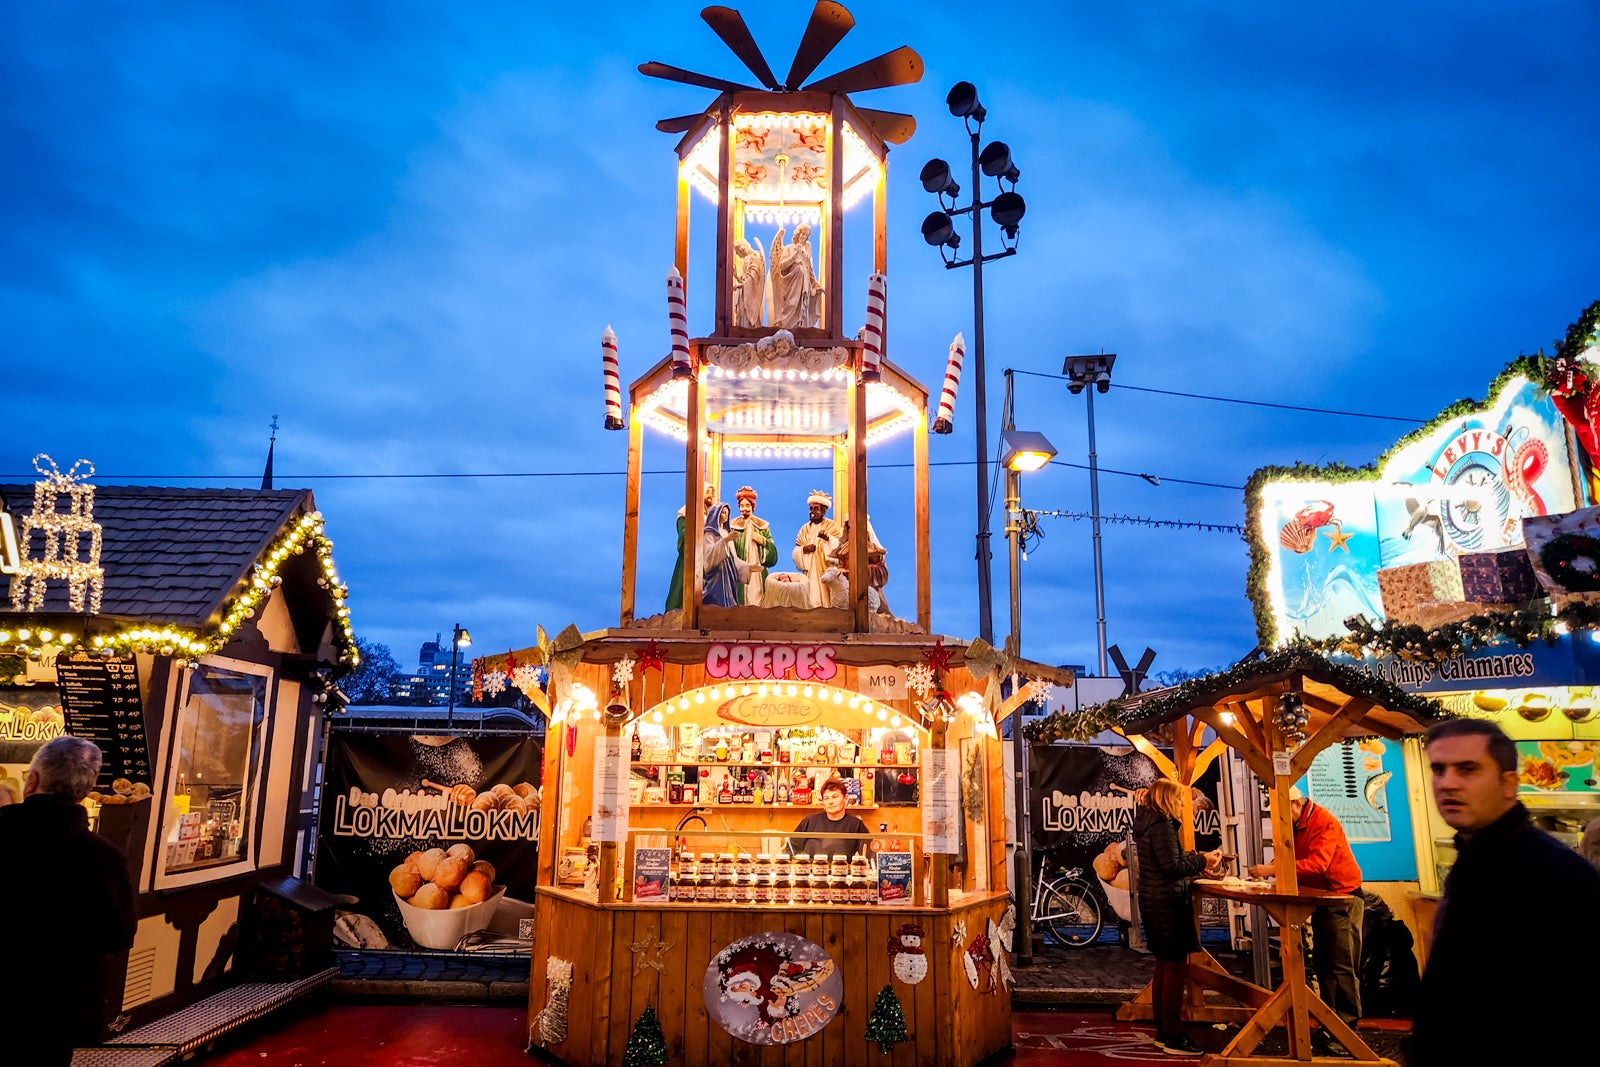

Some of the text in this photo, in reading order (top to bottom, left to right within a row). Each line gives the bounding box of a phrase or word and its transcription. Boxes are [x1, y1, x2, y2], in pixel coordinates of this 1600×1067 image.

[1433, 431, 1505, 480] LEVY'S
[706, 644, 838, 681] CREPES
[1390, 660, 1432, 688] Chips
[1439, 653, 1535, 682] Calamares
[869, 675, 896, 687] M19
[738, 698, 811, 724] Crêperie
[349, 786, 450, 815] Das Original
[1052, 790, 1134, 811] Das Original
[770, 993, 837, 1042] CREPES
